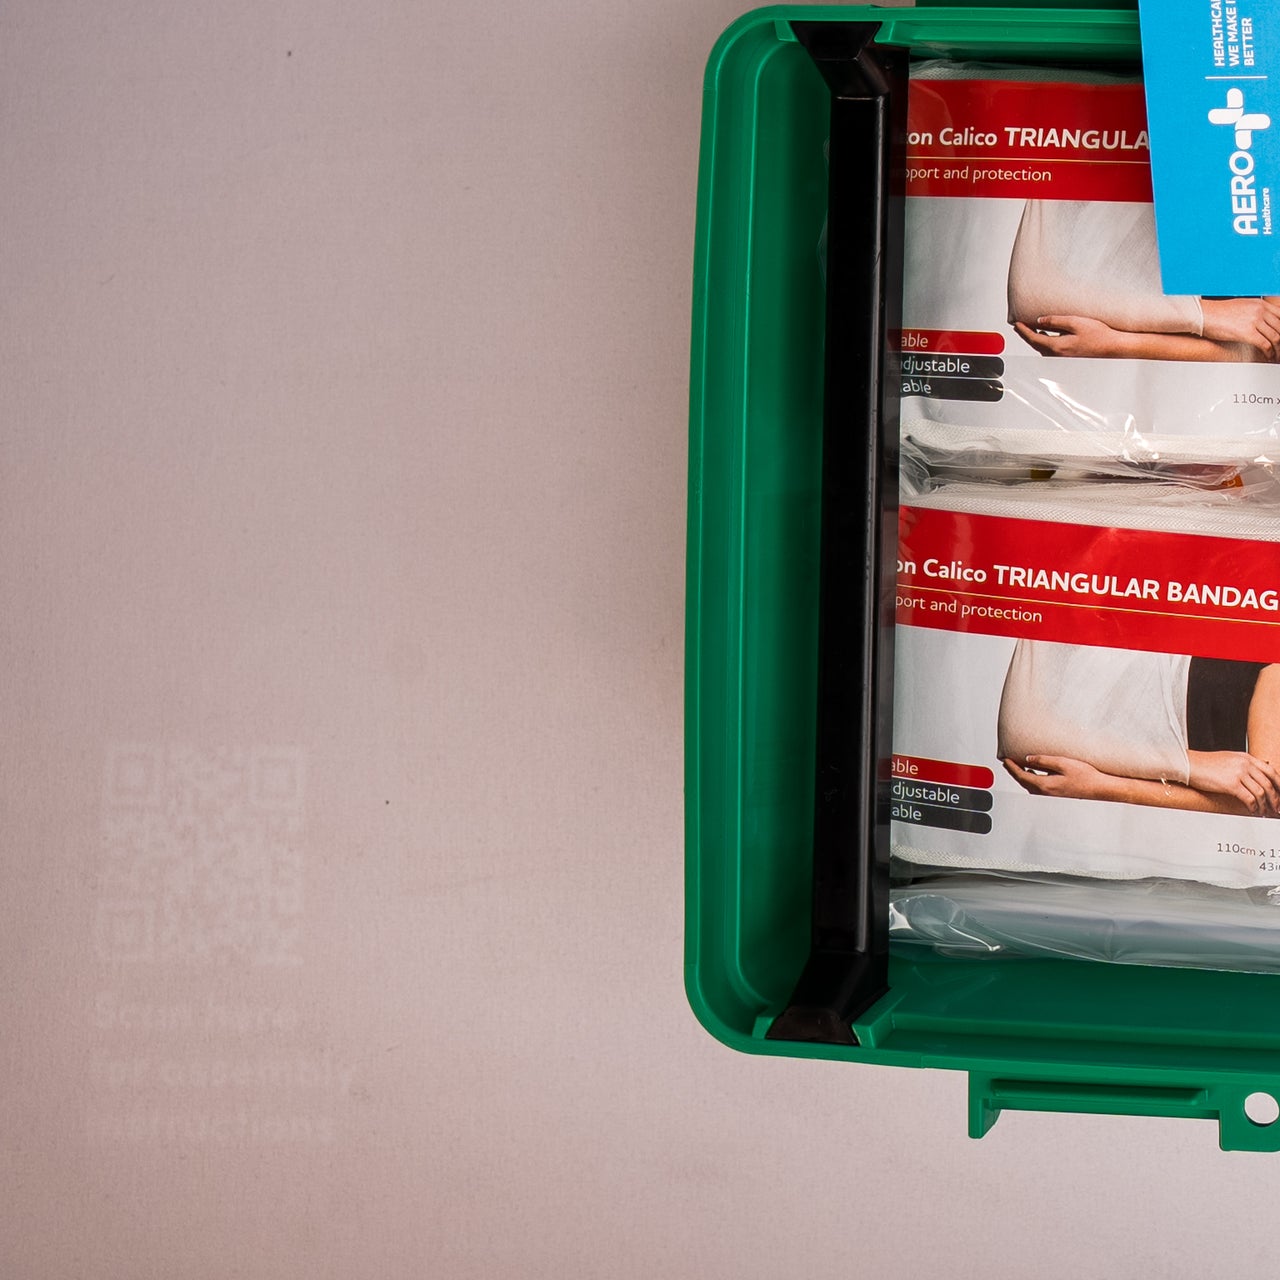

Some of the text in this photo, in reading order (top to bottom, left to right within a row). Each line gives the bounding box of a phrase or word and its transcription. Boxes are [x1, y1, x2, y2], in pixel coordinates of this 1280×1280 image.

[1225, 6, 1238, 42] MAKE
[1241, 17, 1254, 65] BETTER
[1228, 45, 1239, 66] WE
[939, 126, 997, 145] Calico
[1229, 153, 1258, 235] AERO
[1261, 187, 1271, 234] Healthcare
[923, 558, 986, 582] Calico
[993, 564, 1159, 599] TRIANGULAR
